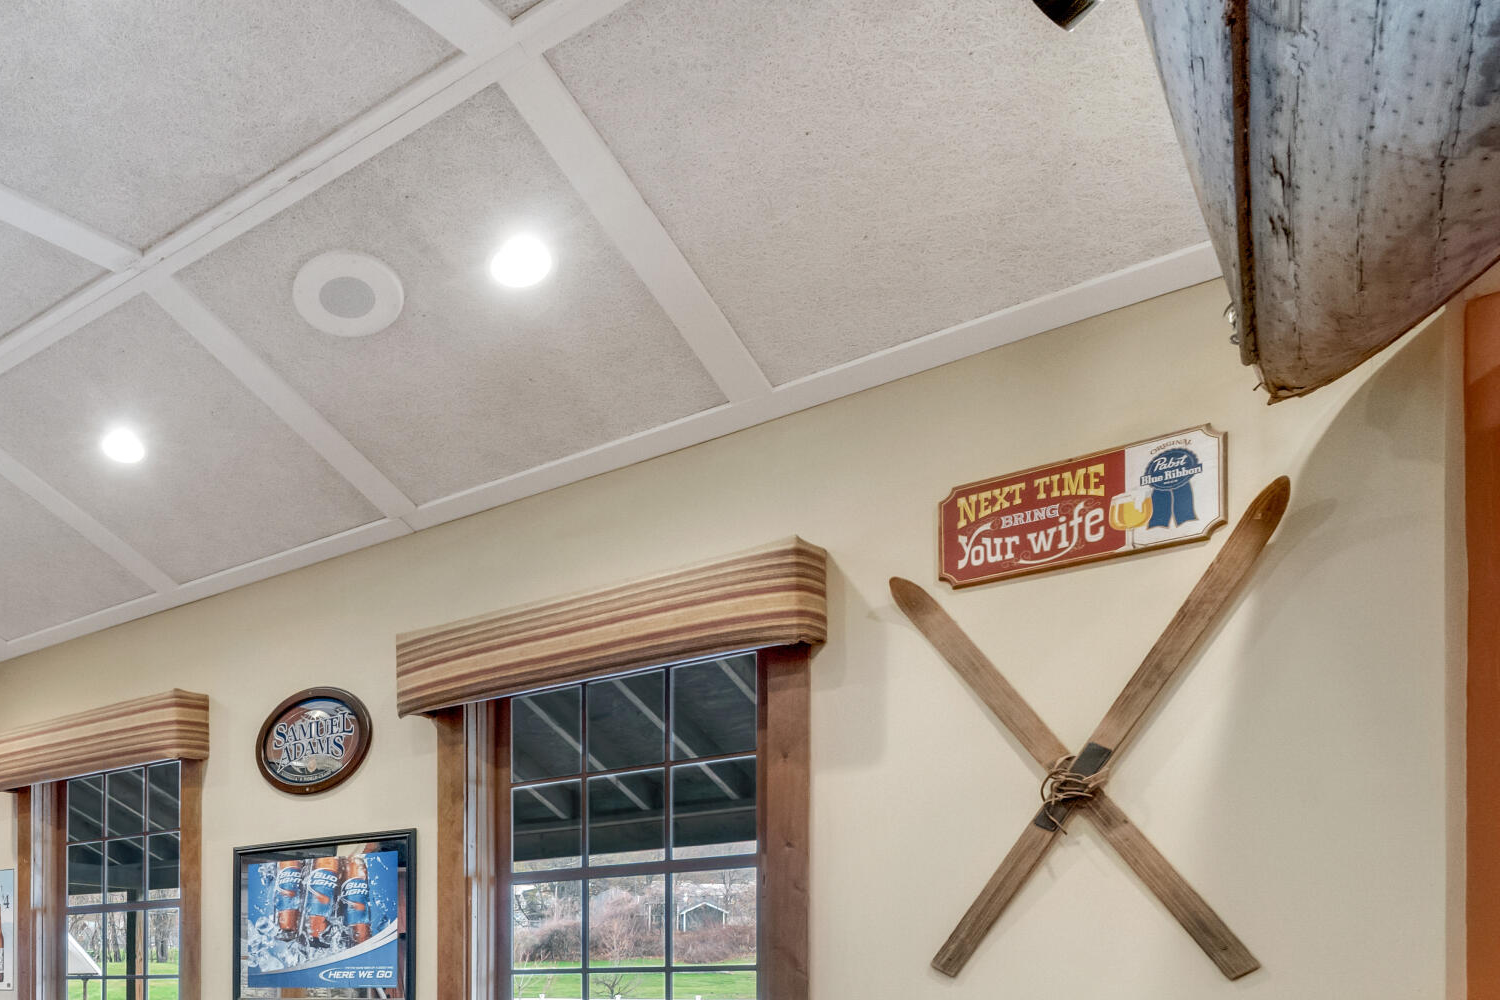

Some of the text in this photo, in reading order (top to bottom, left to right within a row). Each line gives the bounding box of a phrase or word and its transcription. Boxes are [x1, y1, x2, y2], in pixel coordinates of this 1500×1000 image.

[1153, 454, 1188, 472] Pabst
[1141, 475, 1163, 486] Blue
[1164, 466, 1202, 480] Ribbon
[957, 463, 1105, 529] NEXT TIME
[1000, 503, 1060, 529] BRING
[1019, 501, 1105, 564] wife
[273, 712, 354, 750] SAMUEL
[281, 735, 345, 764] ADAMS
[314, 872, 338, 882] BUD
[345, 882, 368, 890] BUD
[328, 970, 393, 979] HERE WE GO
